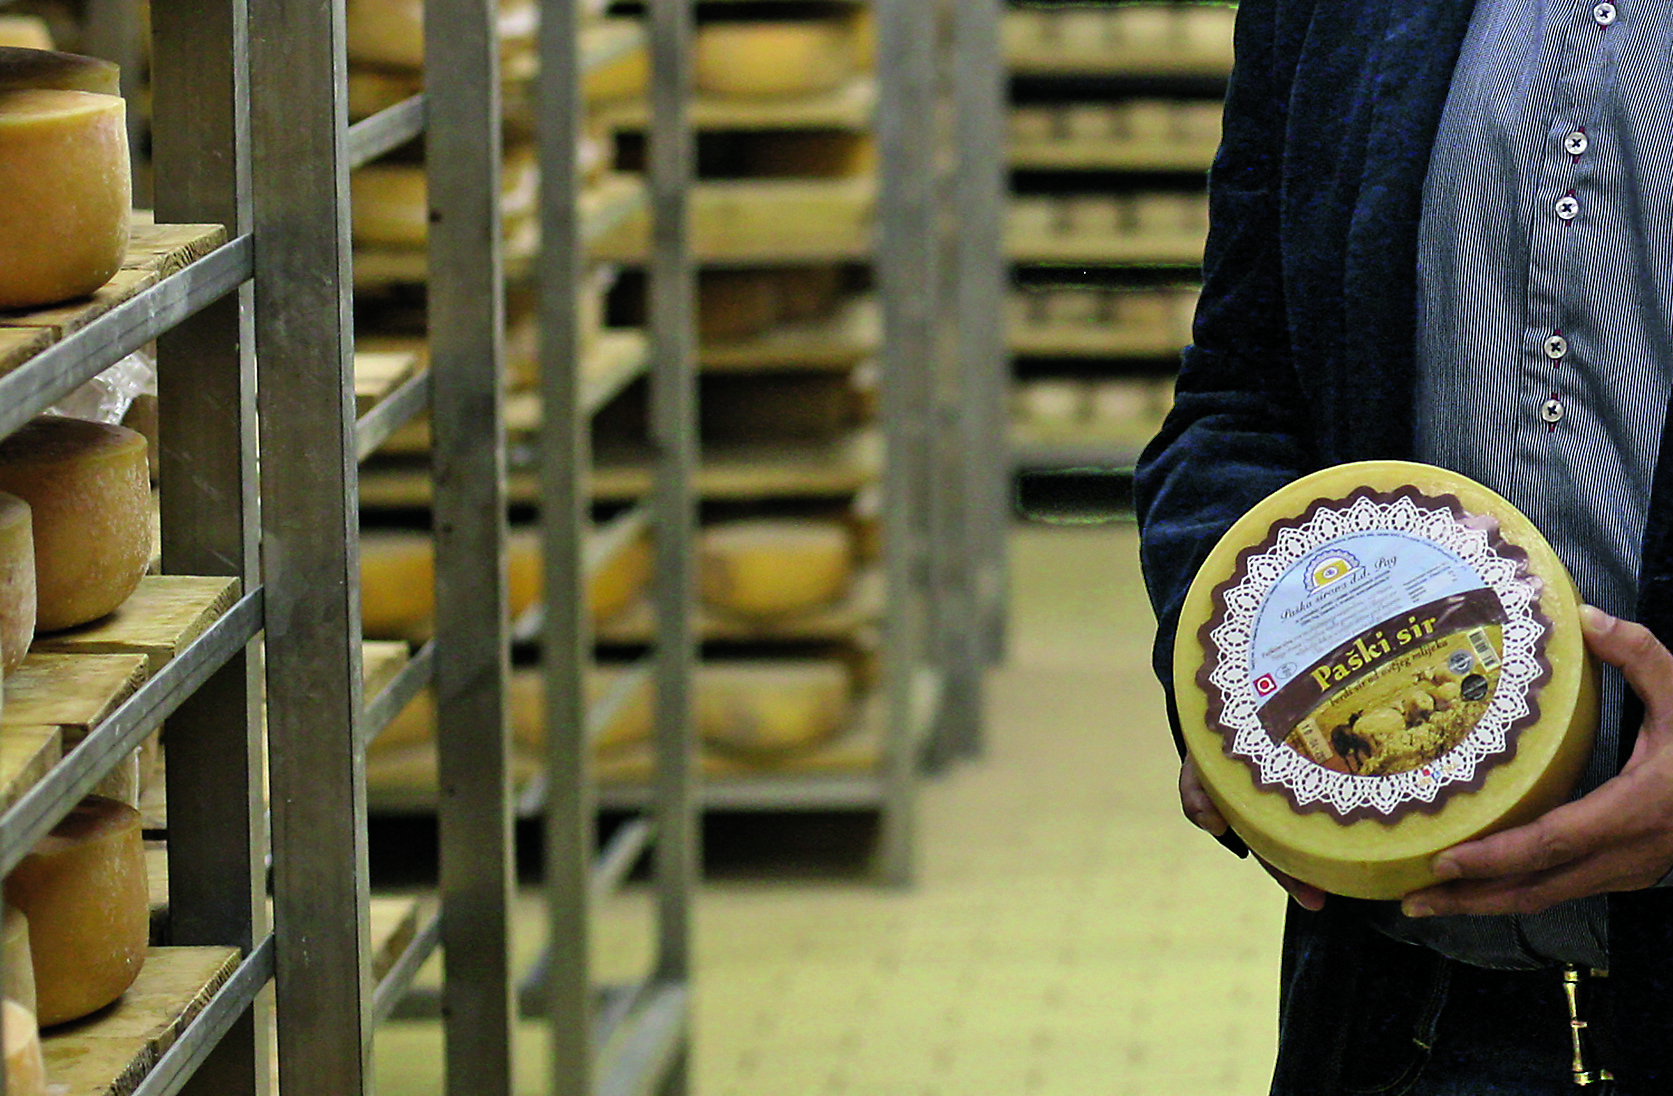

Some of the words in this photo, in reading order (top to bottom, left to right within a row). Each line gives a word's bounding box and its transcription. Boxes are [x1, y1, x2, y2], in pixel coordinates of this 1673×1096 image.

[1374, 556, 1397, 572] Pag
[1310, 630, 1391, 692] Paški
[1396, 615, 1437, 645] sir
